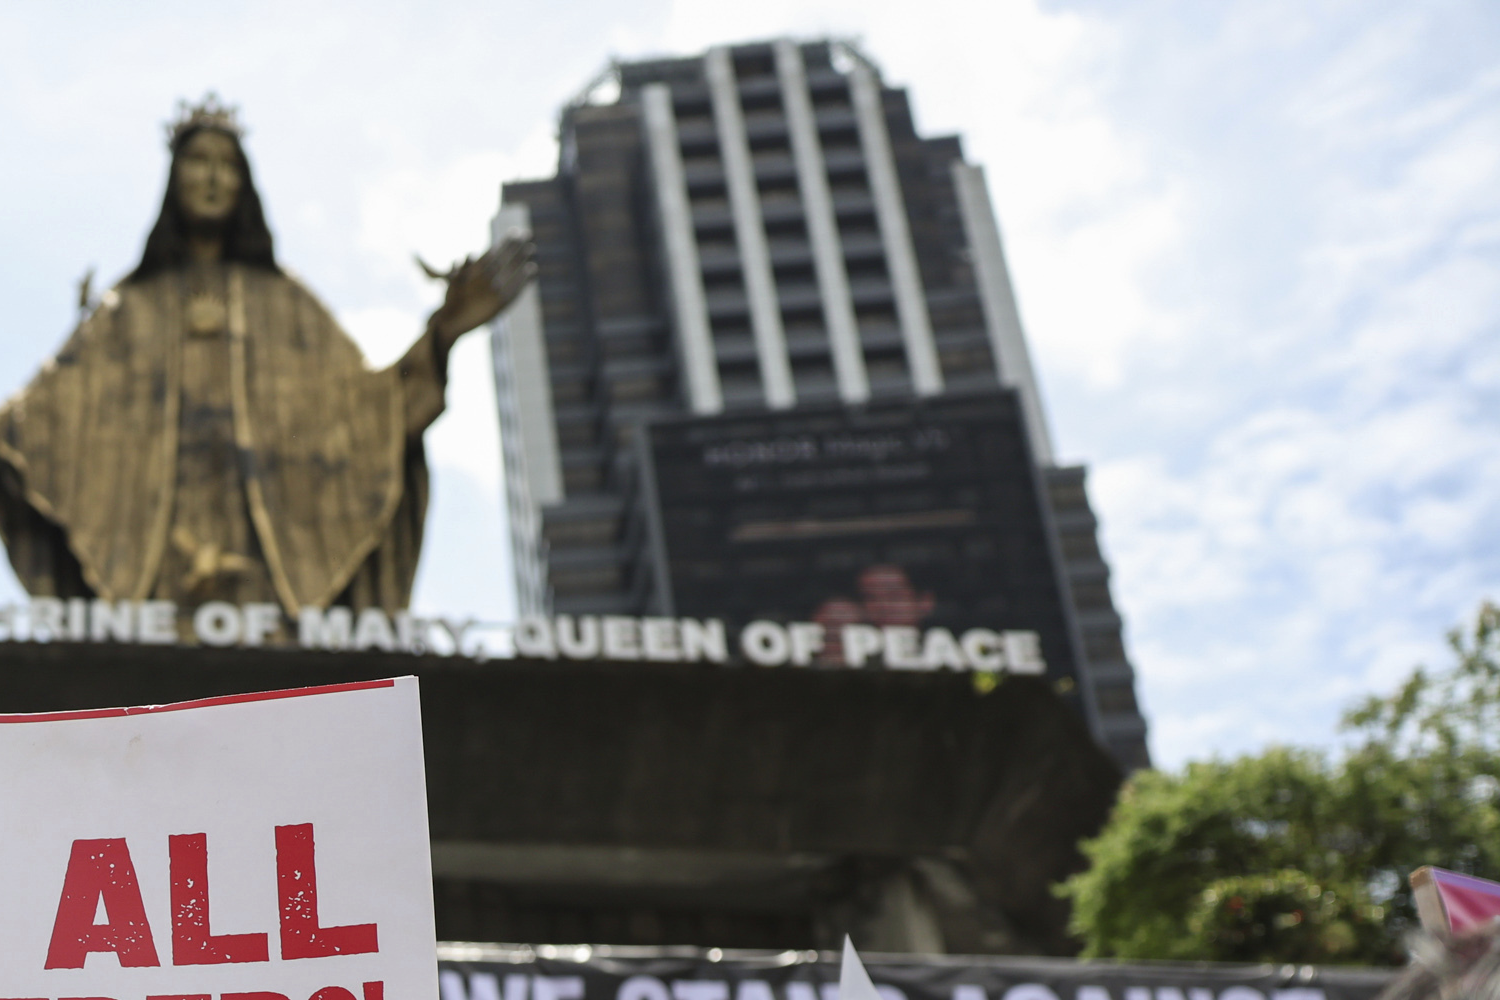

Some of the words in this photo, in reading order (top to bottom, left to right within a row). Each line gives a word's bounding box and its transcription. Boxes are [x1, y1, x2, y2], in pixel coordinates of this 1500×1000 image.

[193, 602, 281, 646] OF
[515, 613, 727, 662] QUEEN
[741, 620, 826, 666] OF
[842, 623, 1046, 674] PEACE
[44, 823, 379, 969] ALL
